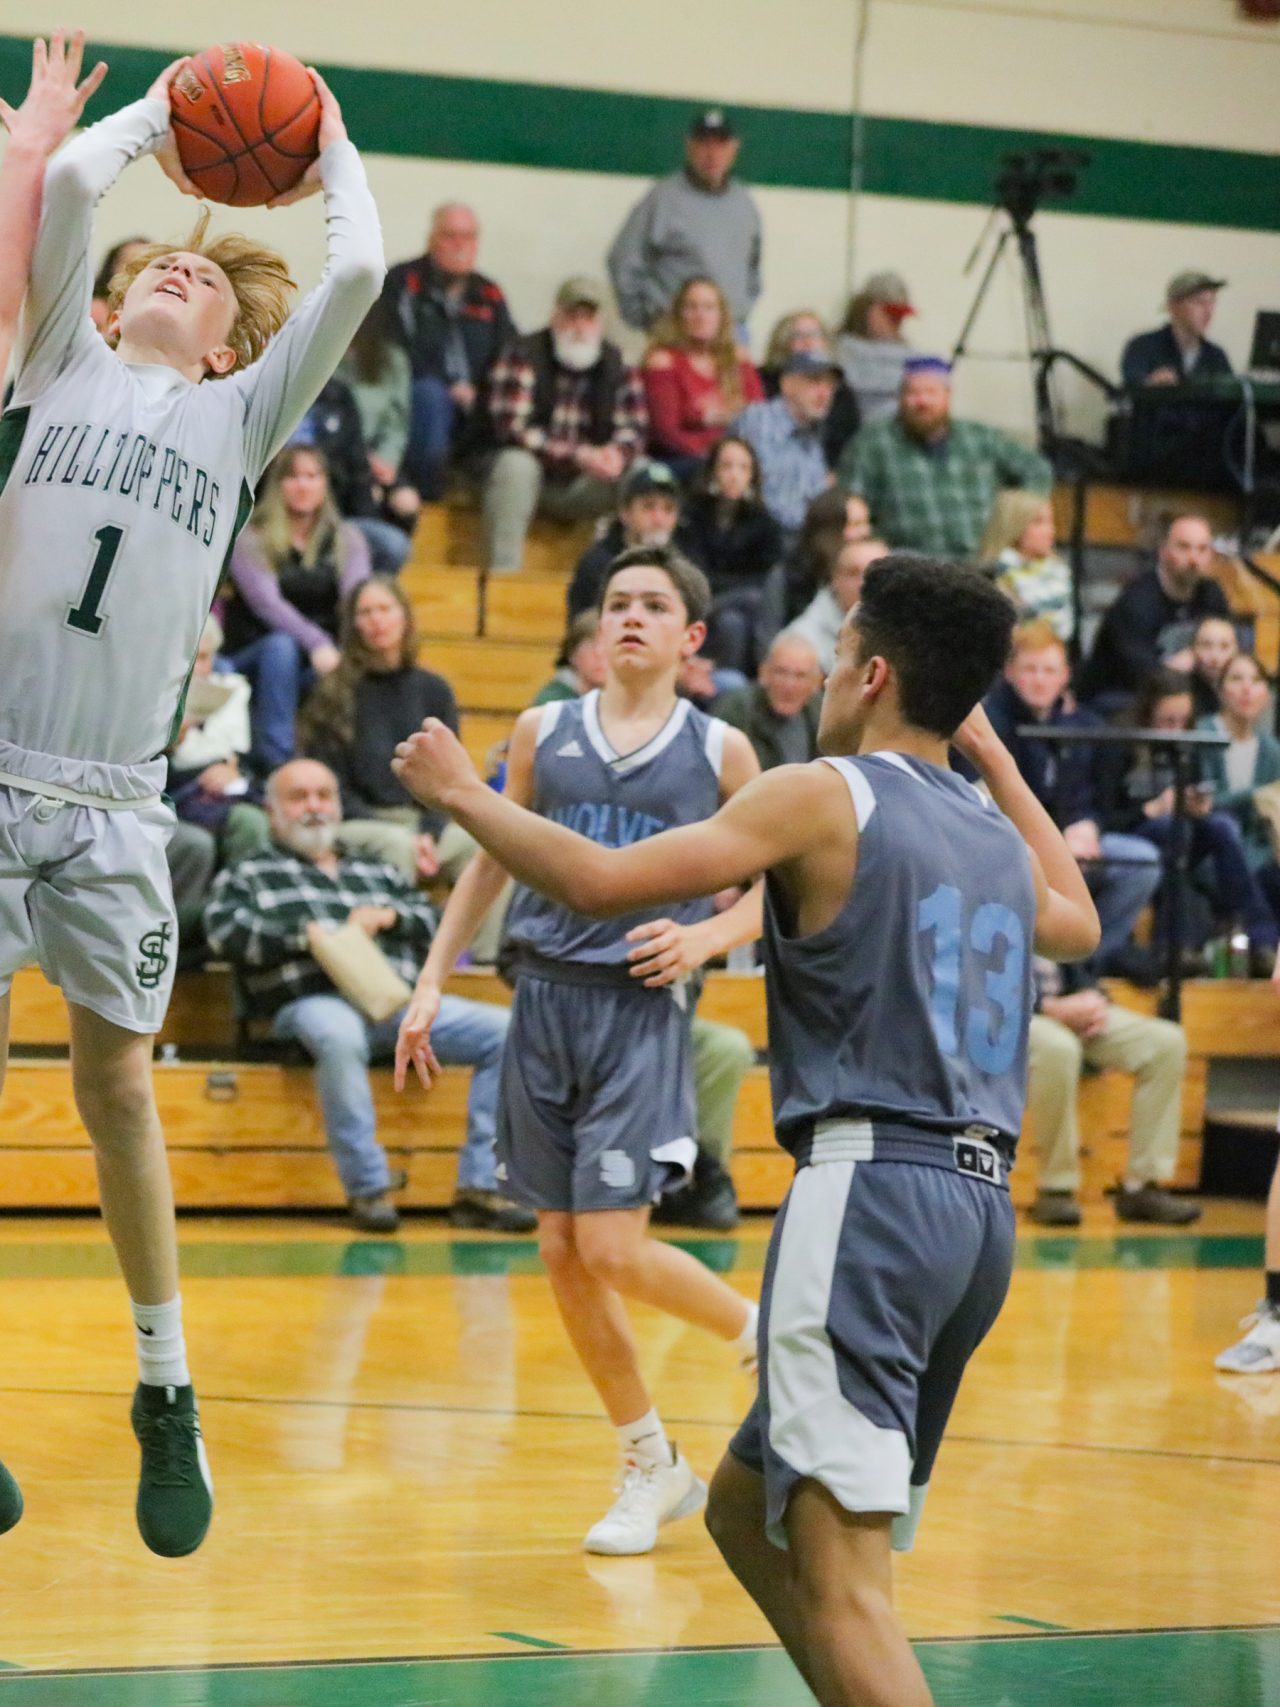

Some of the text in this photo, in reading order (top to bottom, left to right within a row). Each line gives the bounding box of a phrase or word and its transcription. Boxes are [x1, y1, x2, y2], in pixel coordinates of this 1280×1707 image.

[24, 424, 220, 548] HILLTOPPERS
[65, 523, 125, 636] 1
[917, 883, 1025, 1075] 13
